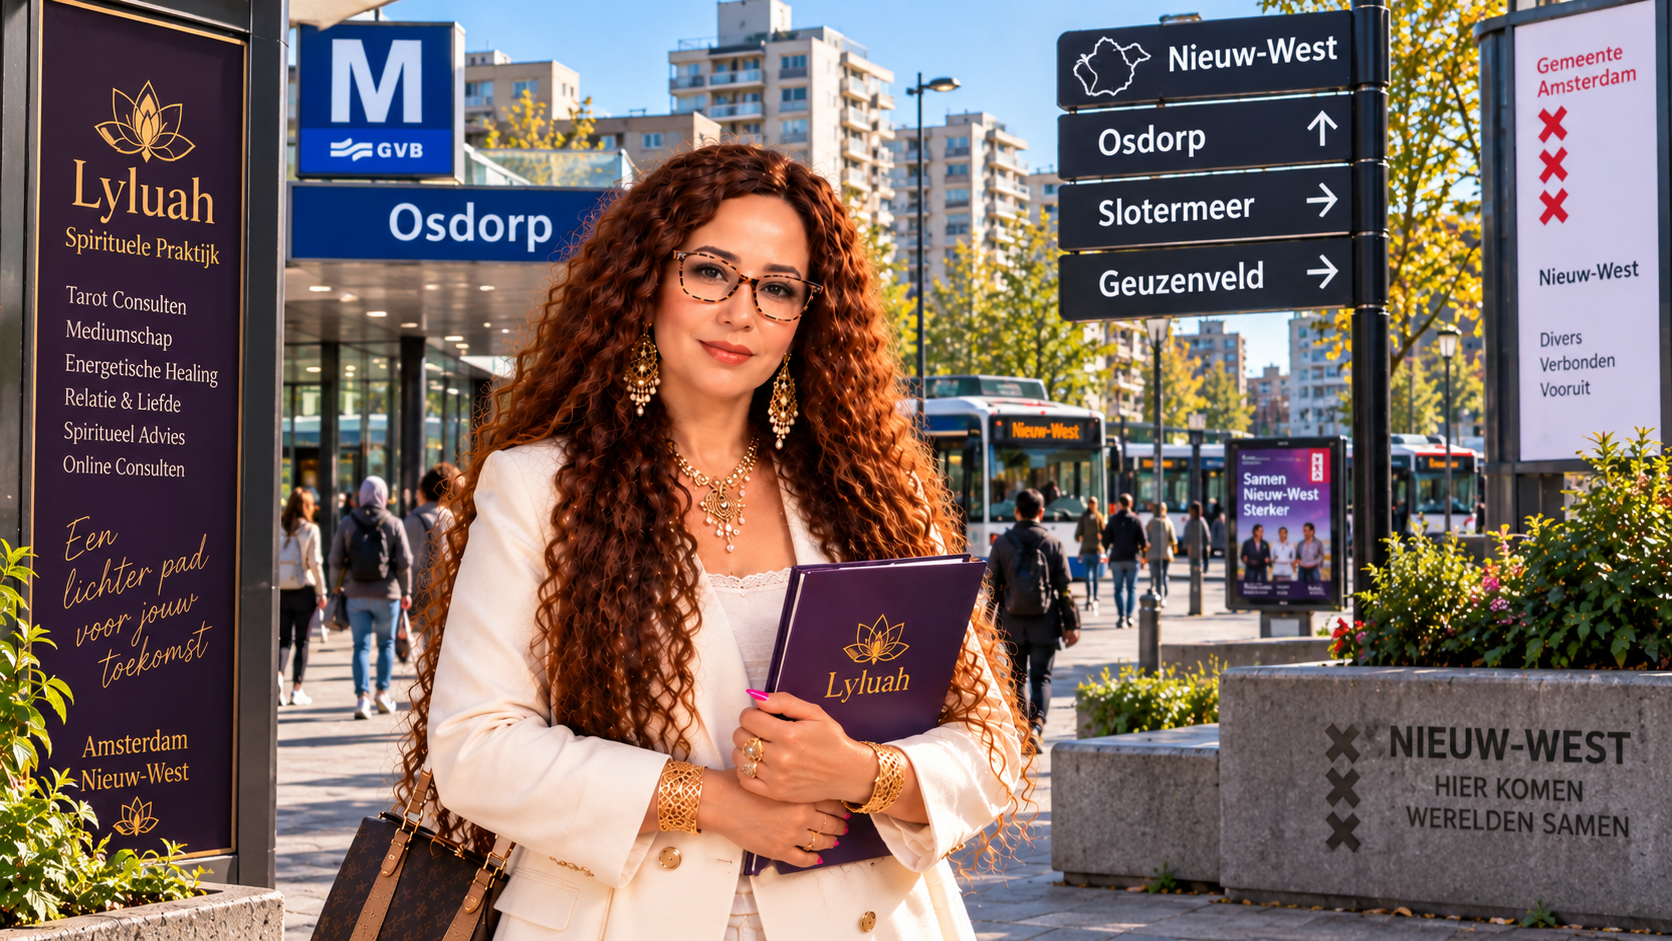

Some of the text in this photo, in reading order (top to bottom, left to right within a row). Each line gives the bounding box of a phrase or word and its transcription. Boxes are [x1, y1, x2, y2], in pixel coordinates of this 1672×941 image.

[1169, 36, 1337, 72] Nieuw-West
[1537, 45, 1623, 74] Gemeente
[331, 39, 422, 123] M
[1537, 66, 1637, 98] Amsterdam
[377, 142, 423, 158] GVB
[1098, 124, 1206, 158] Osdorp
[72, 159, 215, 224] Lyluah
[1098, 196, 1255, 226] Slotermeer
[389, 202, 553, 252] Osdorp
[65, 226, 220, 268] Spirituele Praktijk
[1099, 260, 1264, 297] Geuzenveld
[1539, 260, 1639, 287] Nieuw-West
[65, 285, 187, 315] Tarot Consulten
[65, 319, 173, 351] Mediumschap
[1540, 331, 1583, 348] Divers
[65, 353, 218, 388] Energetische Healing
[1540, 353, 1616, 373] Verbonden
[65, 388, 182, 413] Relatie & Liefde
[1540, 379, 1591, 398] Vooruit
[63, 421, 186, 446] Spiritueel Advies
[1012, 421, 1080, 440] Nieuw-West
[63, 454, 185, 478] Online Consulten
[1243, 472, 1286, 486] Samen
[1243, 487, 1319, 501] Nieuw-West
[1243, 503, 1290, 517] Sterker
[65, 515, 118, 562] Een
[63, 533, 209, 610] lichter pad
[75, 592, 199, 647] voor jouw
[97, 621, 213, 689] toekomst
[824, 667, 910, 703] Lyluah
[82, 729, 188, 758] Amsterdam
[1389, 725, 1631, 764] NIEUW-WEST
[80, 762, 190, 792] Nieuw-West
[1435, 775, 1583, 802] HIER KOMEN
[1406, 806, 1630, 838] WERELDEN SAMEN
